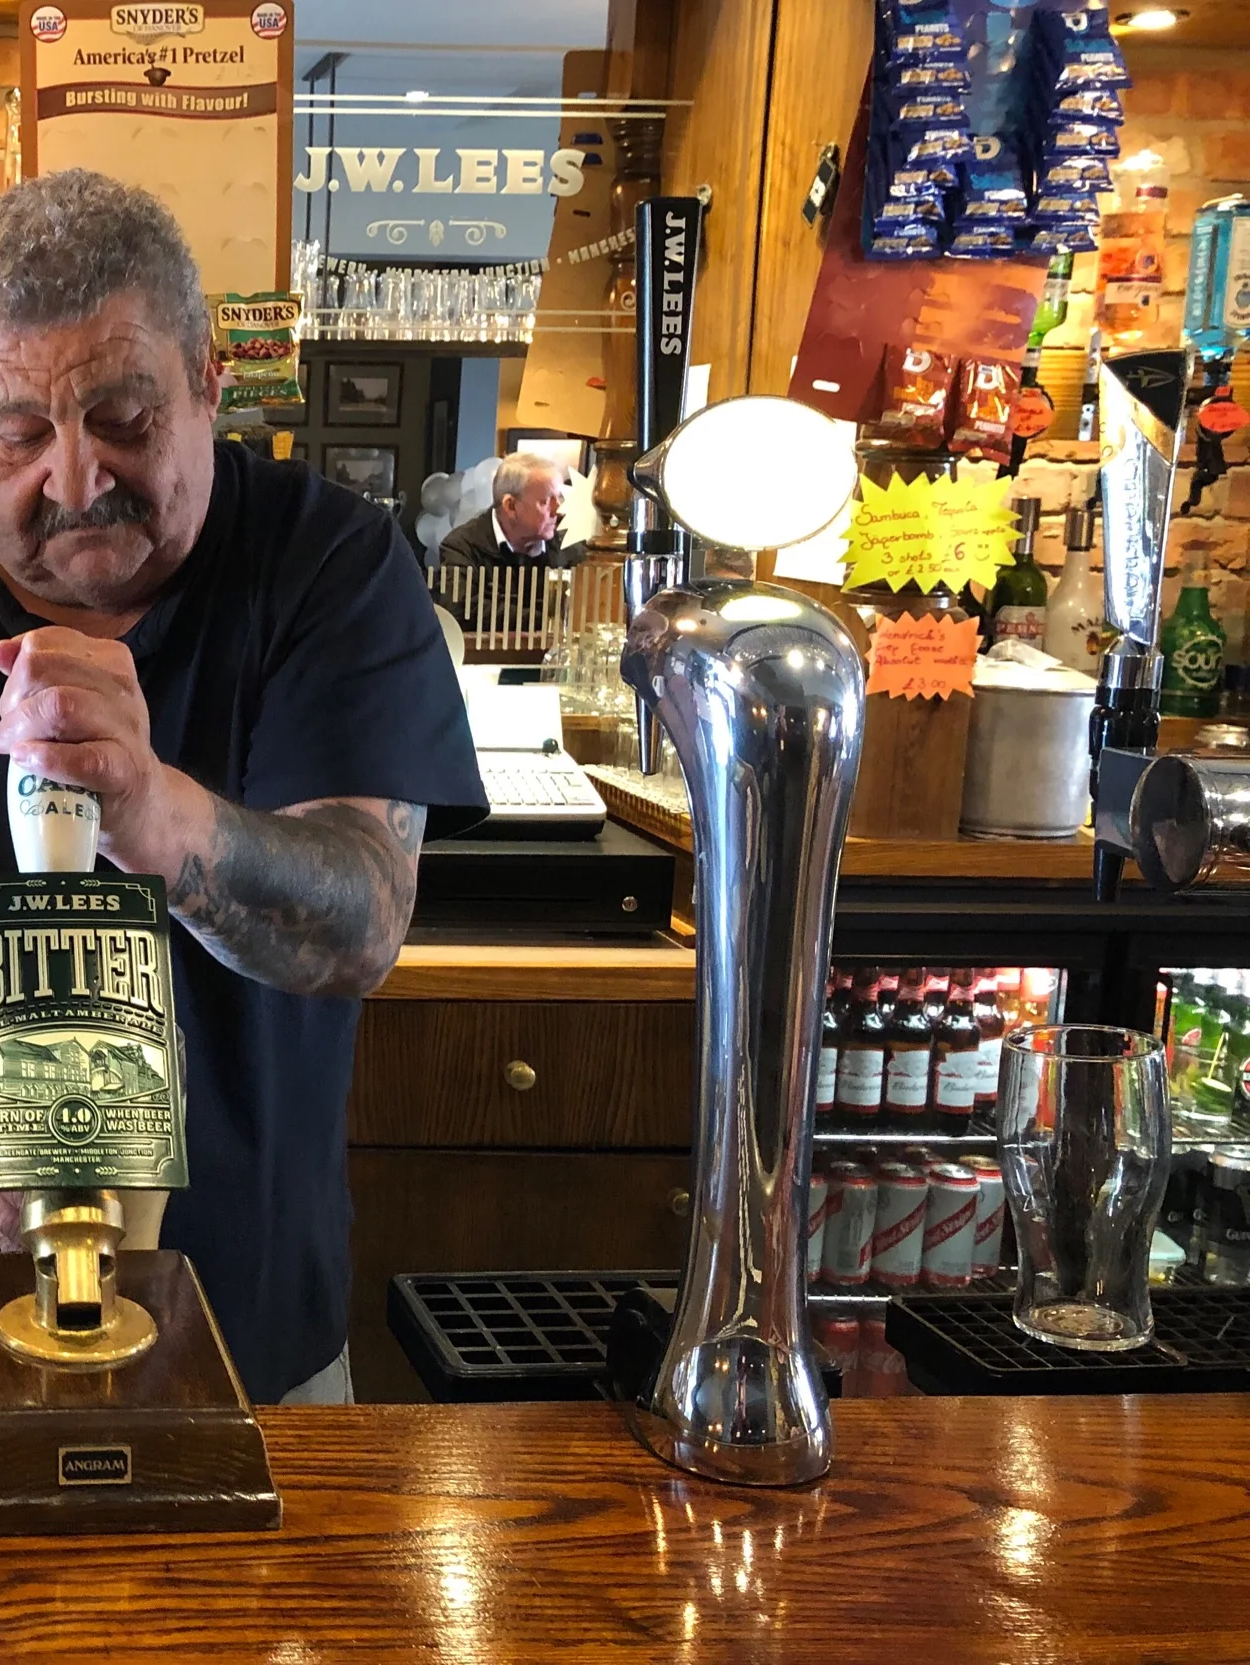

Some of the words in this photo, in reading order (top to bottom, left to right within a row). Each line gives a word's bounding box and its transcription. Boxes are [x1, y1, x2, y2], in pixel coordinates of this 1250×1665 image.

[116, 7, 198, 25] SNYDER'S
[39, 21, 59, 32] USA
[258, 18, 279, 28] USA
[73, 48, 156, 65] America's
[159, 48, 177, 64] #1
[182, 45, 244, 64] Pretzel
[65, 88, 137, 108] Bursting
[141, 92, 177, 109] with
[182, 92, 249, 111] Flavour!
[221, 306, 295, 322] SNYDER'S
[45, 801, 84, 817] ALE
[64, 1009, 126, 1024] AMBER
[127, 1018, 165, 1037] ALE
[24, 1108, 46, 1122] OF
[104, 1108, 140, 1120] WHEN
[144, 1109, 171, 1120] BEER
[106, 1120, 134, 1132] WAS
[138, 1121, 172, 1132] BEER
[39, 1148, 72, 1156] BREWERY
[80, 1148, 118, 1156] MIDDLETON
[120, 1148, 154, 1156] JUNCTION
[52, 1156, 100, 1164] MANCHESTER
[64, 1460, 125, 1472] ANGRAM
